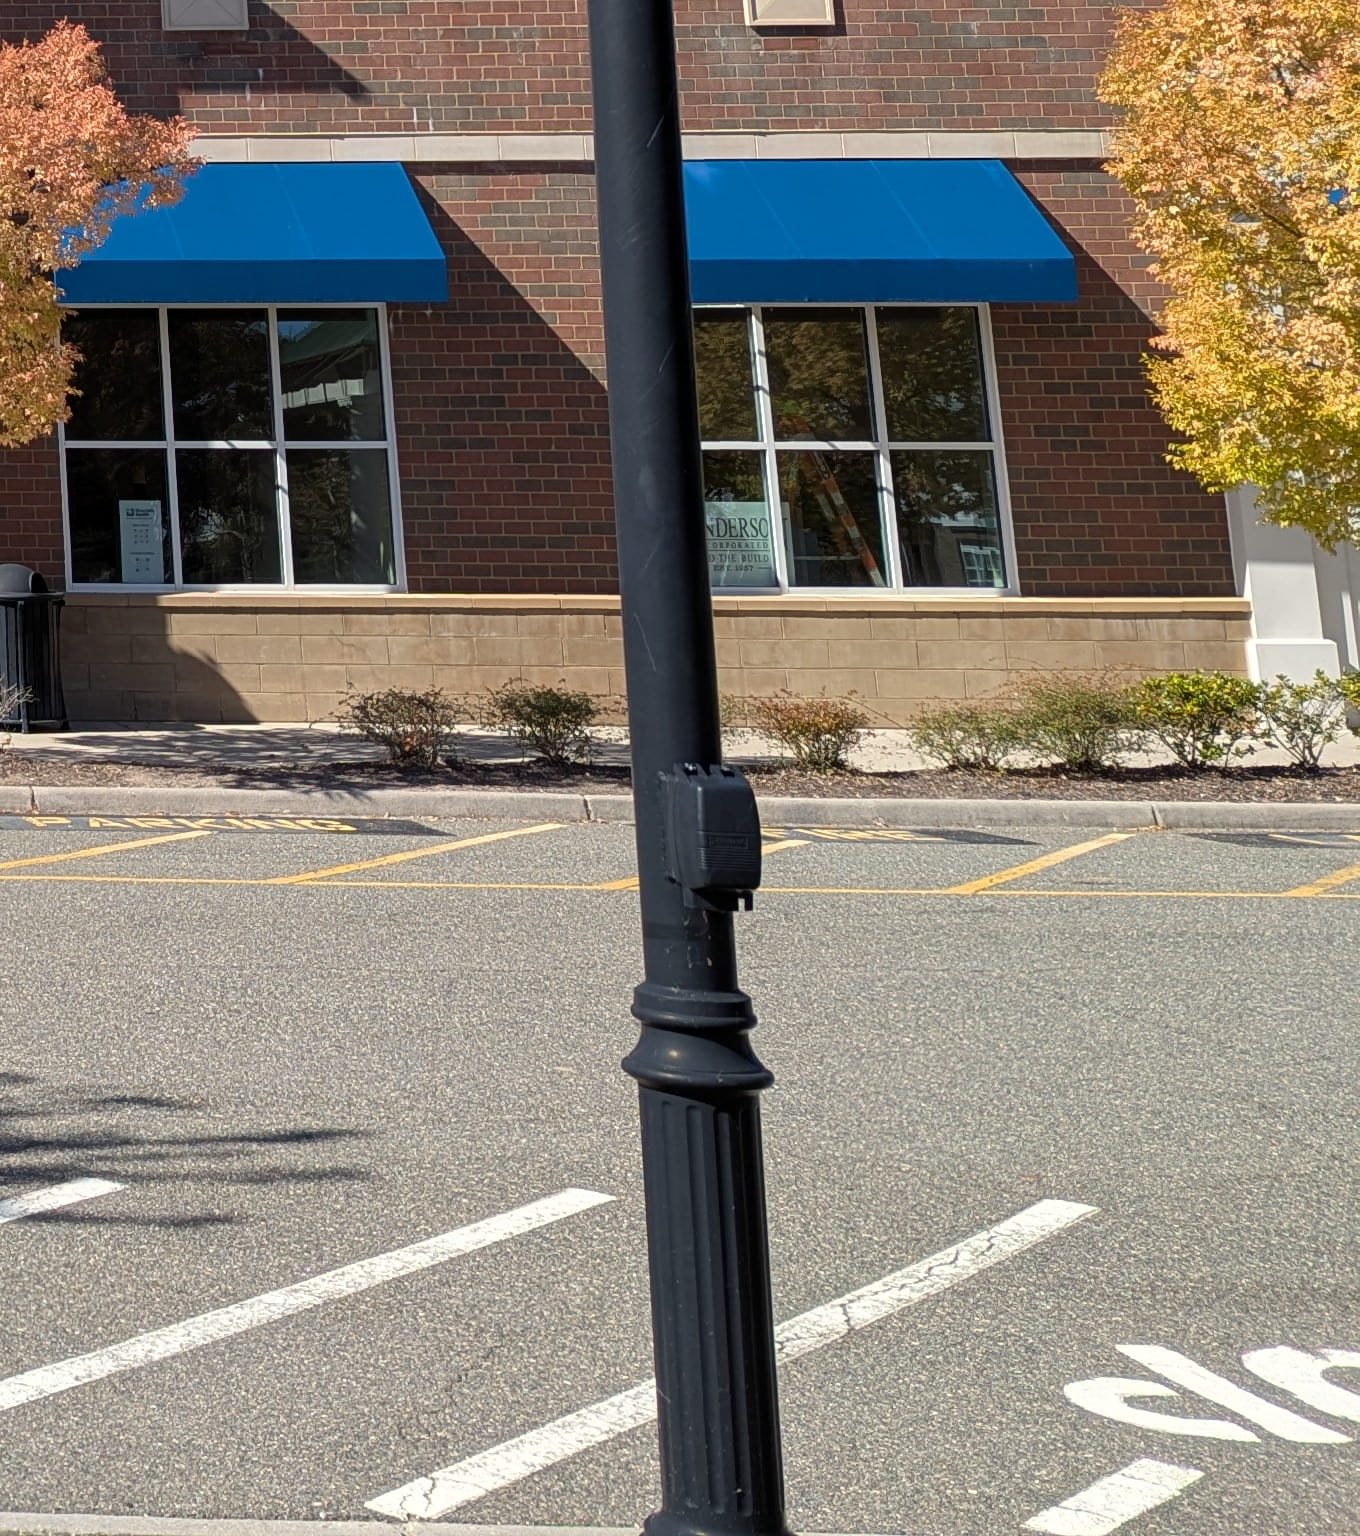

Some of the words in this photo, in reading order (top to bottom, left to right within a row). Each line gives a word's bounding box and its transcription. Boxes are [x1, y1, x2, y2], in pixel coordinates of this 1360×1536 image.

[705, 517, 788, 538] NDERSO
[741, 554, 770, 562] BUILD
[22, 815, 358, 832] PARKING
